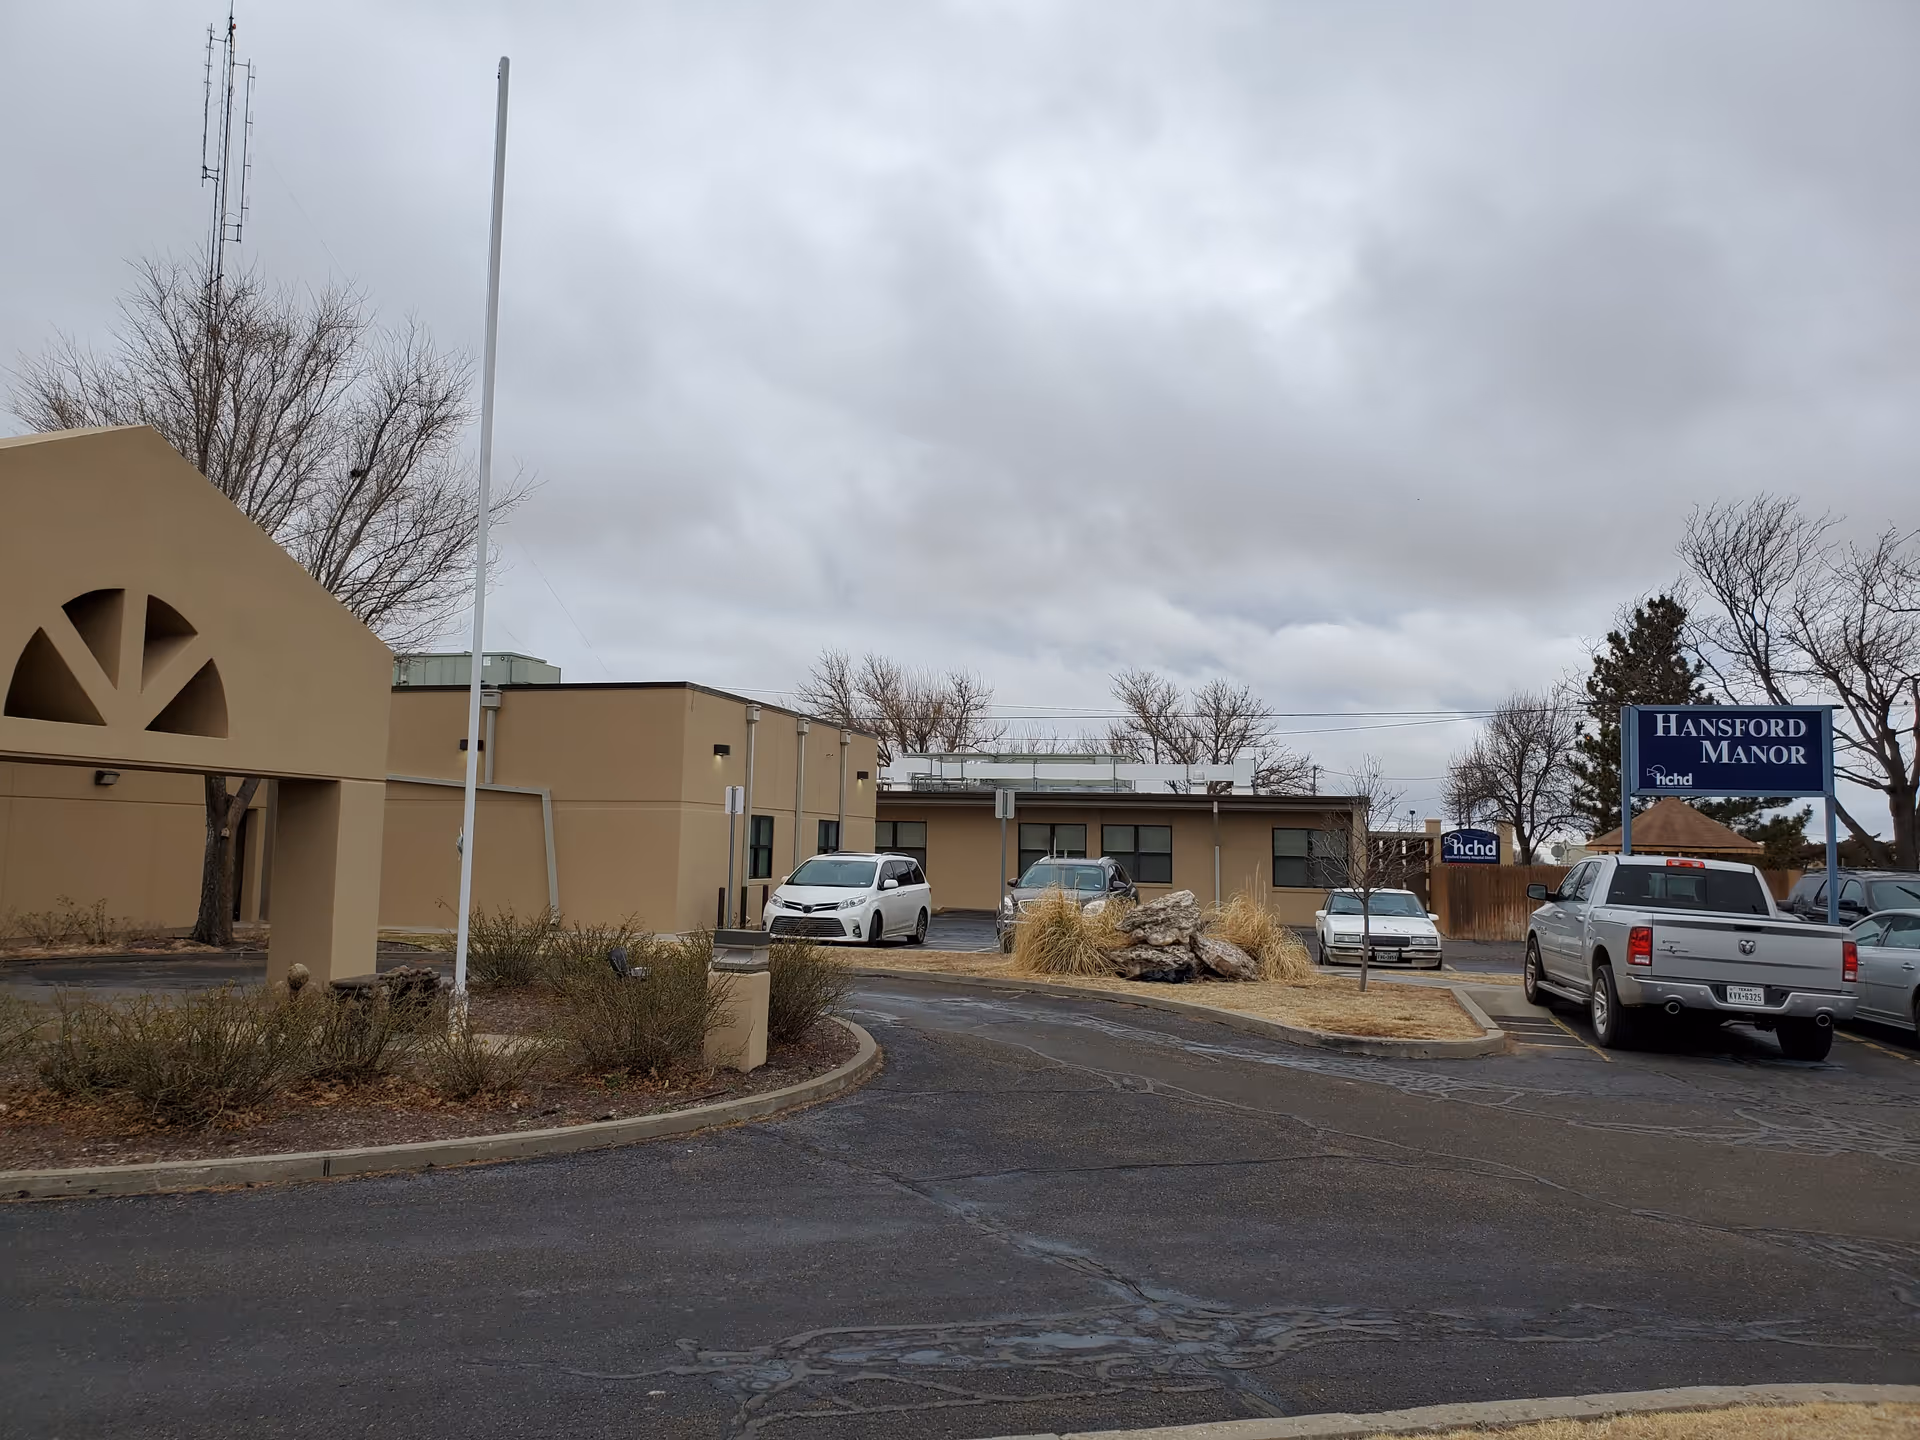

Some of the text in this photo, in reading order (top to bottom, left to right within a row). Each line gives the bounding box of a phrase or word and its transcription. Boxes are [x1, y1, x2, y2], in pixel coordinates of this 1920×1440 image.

[1653, 713, 1807, 738] HANSFORD
[1700, 740, 1807, 765] MANOR
[1656, 772, 1693, 786] hchd
[1453, 839, 1497, 856] hchd
